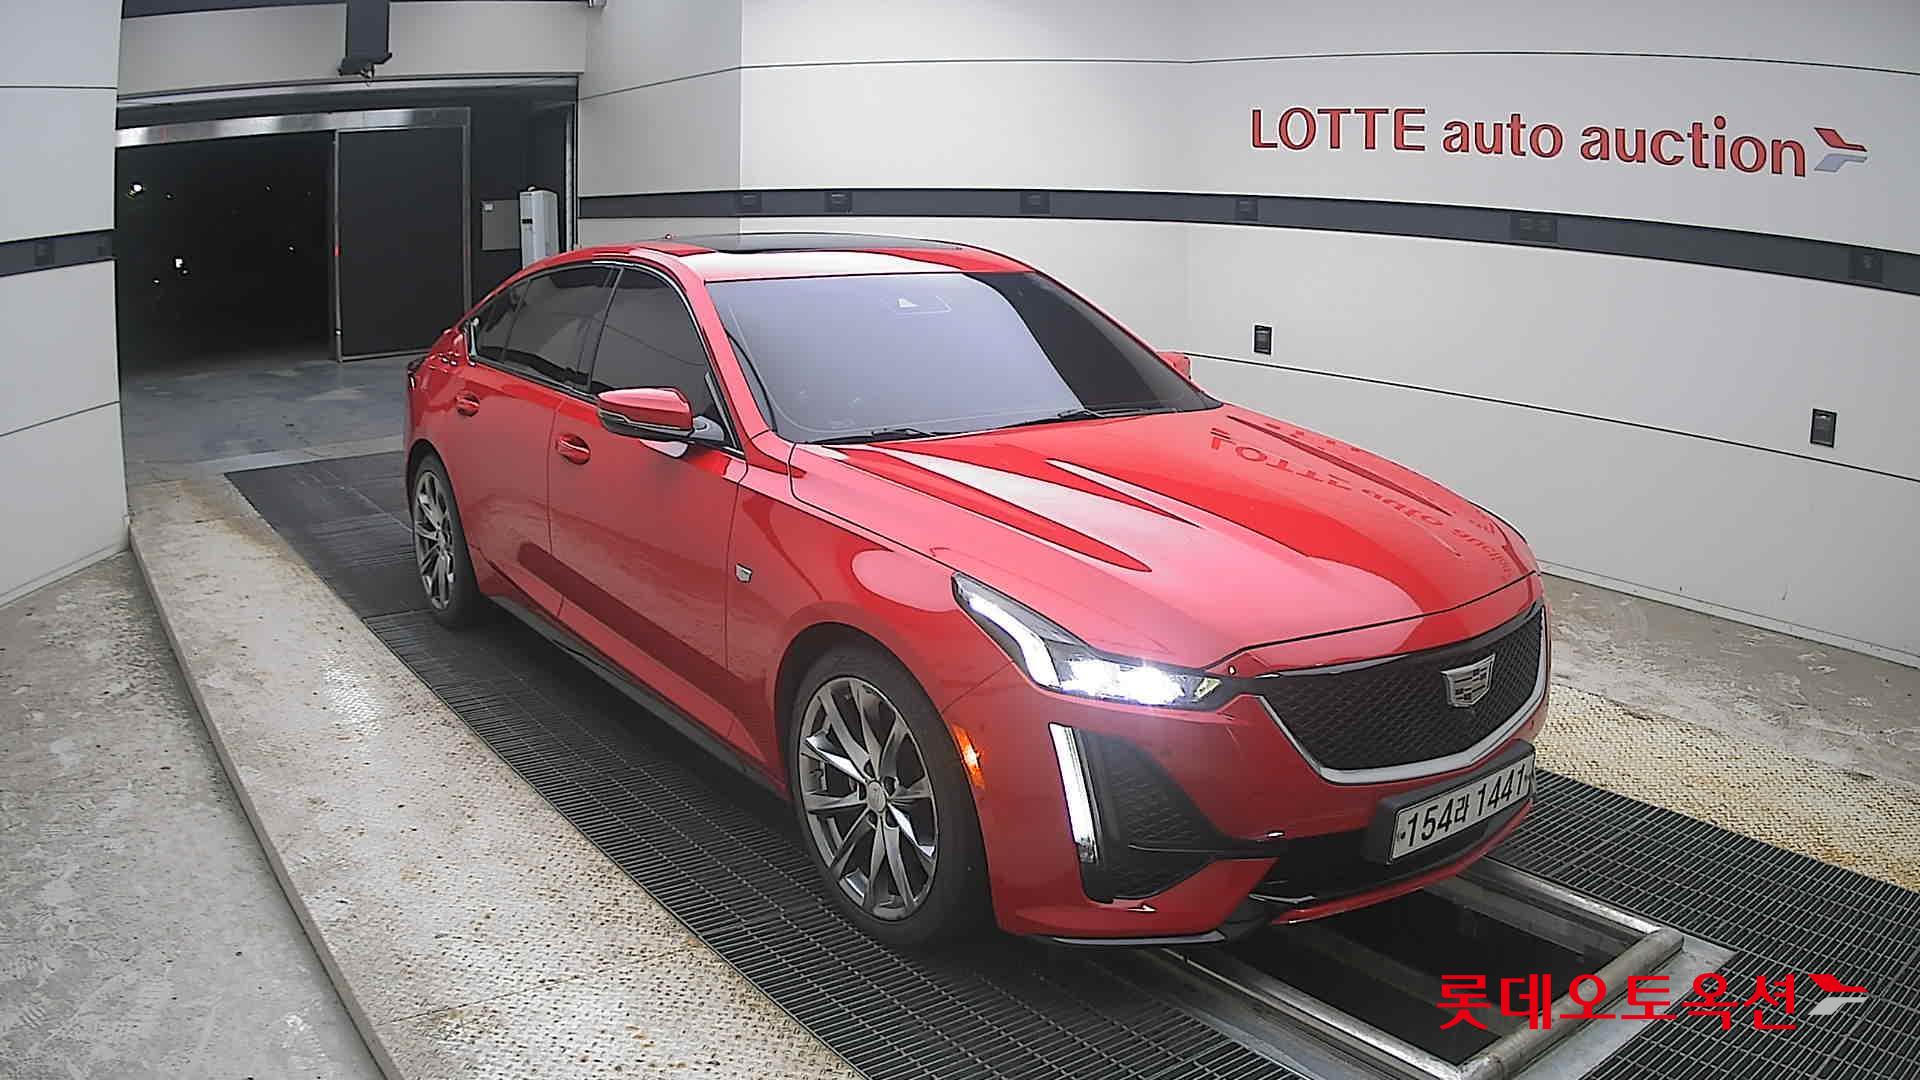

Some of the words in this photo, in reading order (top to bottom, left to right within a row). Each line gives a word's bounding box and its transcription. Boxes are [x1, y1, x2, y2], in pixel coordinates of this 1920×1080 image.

[1252, 107, 1425, 151] LOTTE
[1442, 113, 1563, 158] auto
[1580, 115, 1806, 177] auction
[1477, 763, 1526, 817] 1441
